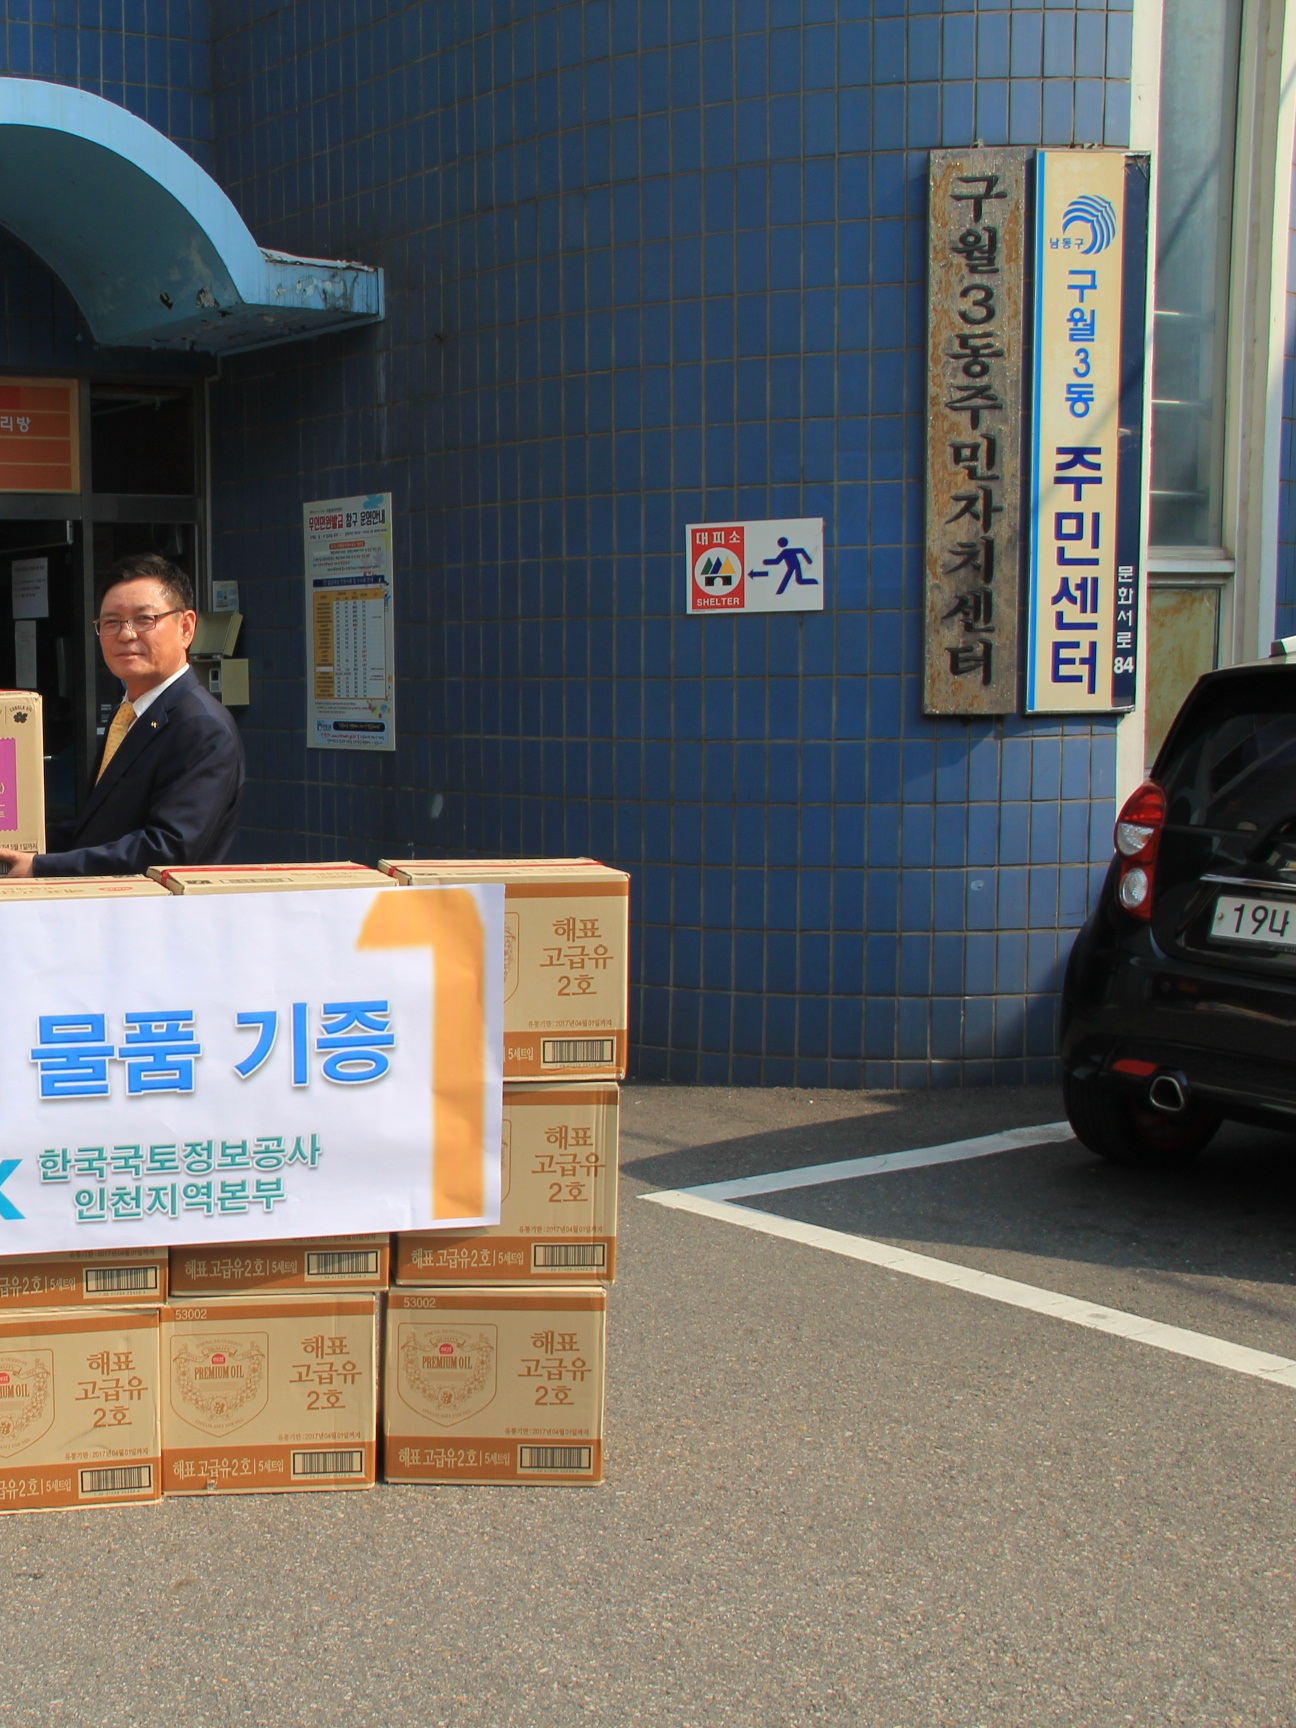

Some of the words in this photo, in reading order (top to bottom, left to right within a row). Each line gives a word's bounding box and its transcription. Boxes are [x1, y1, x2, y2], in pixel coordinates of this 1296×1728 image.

[1050, 238, 1084, 249] 남동구
[1065, 269, 1097, 418] 구월3동
[696, 531, 740, 545] 대피소
[1051, 446, 1103, 694] 주민센터
[697, 597, 740, 606] SHELTER
[1117, 565, 1134, 649] 문화서로
[1113, 656, 1134, 674] 84
[552, 917, 601, 942] 해표
[540, 944, 614, 970] 고급유
[557, 974, 597, 996] 2호
[28, 1008, 203, 1100] 물품
[232, 999, 397, 1088] 기증
[545, 1125, 593, 1150] 해표
[37, 1133, 323, 1183] 한국국토정보공사
[531, 1152, 605, 1177] 고급유
[73, 1178, 287, 1224] 인천지역본부
[549, 1181, 588, 1203] 2호
[175, 1309, 207, 1320] 53002
[404, 1297, 436, 1308] 53002
[301, 1335, 350, 1359] 해표
[531, 1330, 580, 1355] 해표
[86, 1351, 135, 1375] 해표
[194, 1365, 229, 1380] PREMIUM
[231, 1365, 244, 1379] OIL
[289, 1360, 362, 1385] 고급유
[422, 1355, 458, 1369] PREMIUM
[459, 1355, 472, 1369] OIL
[518, 1357, 592, 1382] 고급유
[16, 1384, 30, 1398] OIL
[75, 1376, 148, 1402] 고급유
[306, 1389, 346, 1411] 2호
[535, 1385, 574, 1406] 2호
[93, 1406, 132, 1428] 2호
